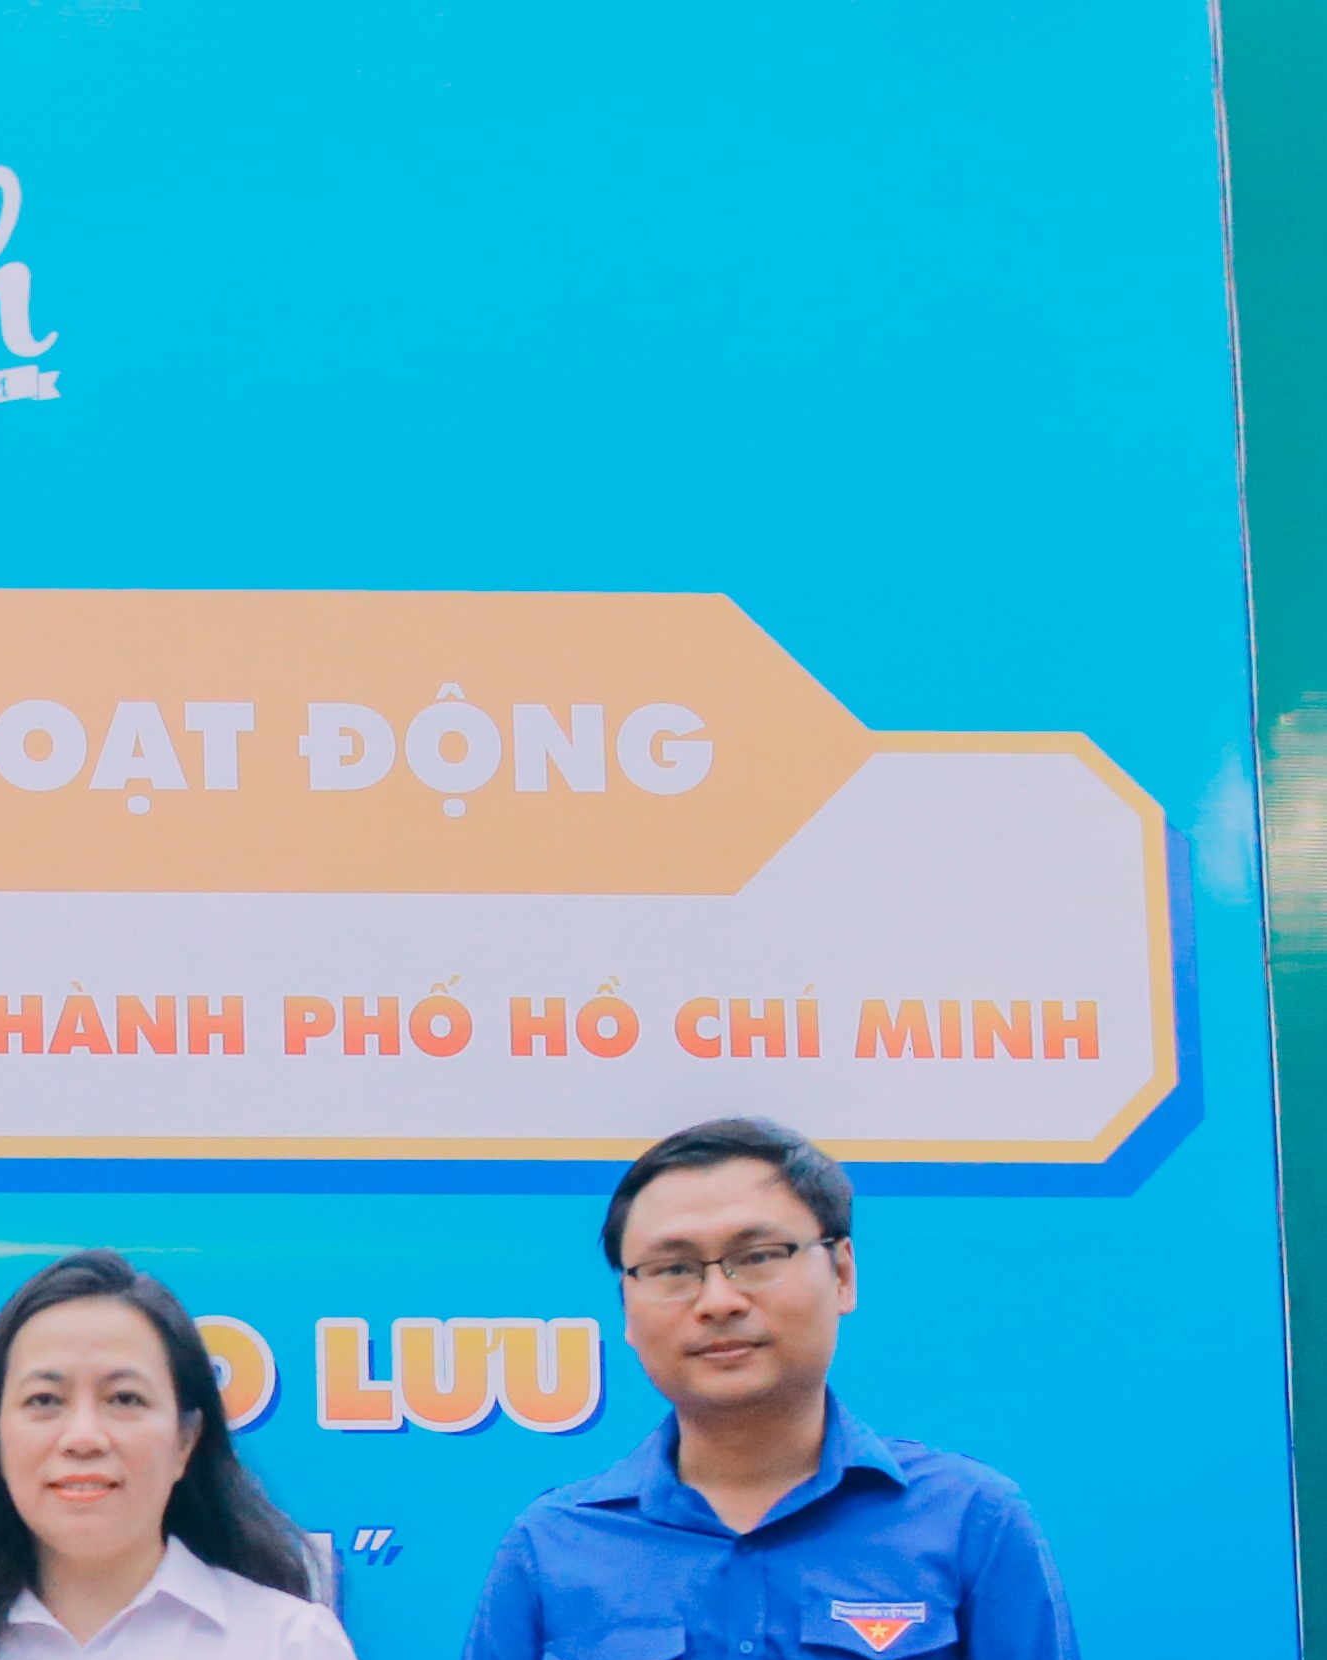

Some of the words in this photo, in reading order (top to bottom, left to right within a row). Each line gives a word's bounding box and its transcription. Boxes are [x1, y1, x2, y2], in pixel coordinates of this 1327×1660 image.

[298, 682, 714, 818] ĐỘNG
[283, 975, 473, 1058] PHỐ
[509, 975, 640, 1059] HỒ
[674, 984, 820, 1059] CHÍ
[855, 999, 1100, 1060] MINH
[315, 1316, 600, 1433] LƯU
